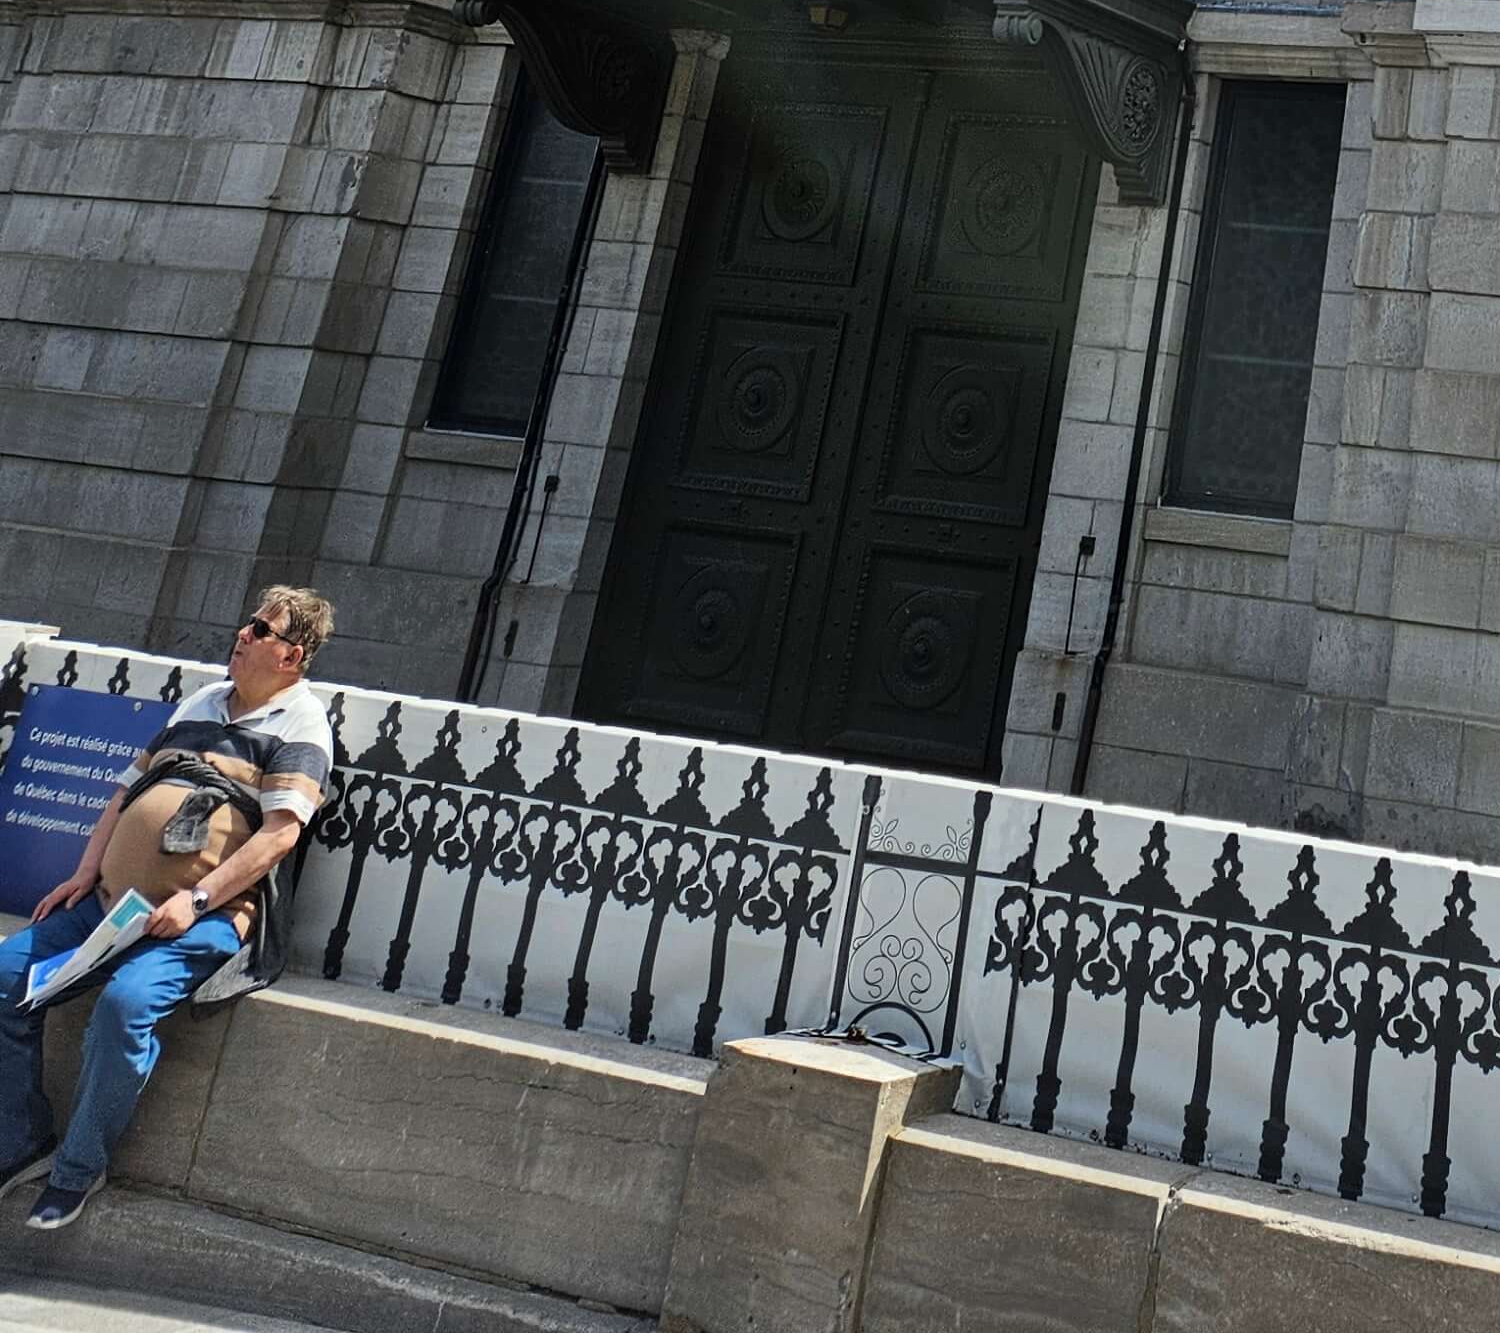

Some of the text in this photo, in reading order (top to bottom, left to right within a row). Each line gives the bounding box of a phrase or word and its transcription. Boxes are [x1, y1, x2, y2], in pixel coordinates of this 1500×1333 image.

[30, 727, 40, 742] Ce
[40, 731, 66, 747] projet
[66, 735, 79, 748] est
[80, 735, 108, 752] réalisé
[108, 742, 130, 757] grâce
[21, 755, 121, 783] du gouvernement du Qu
[13, 781, 111, 810] de Québec dans le cadr
[6, 809, 16, 823] de
[17, 810, 80, 834] développement
